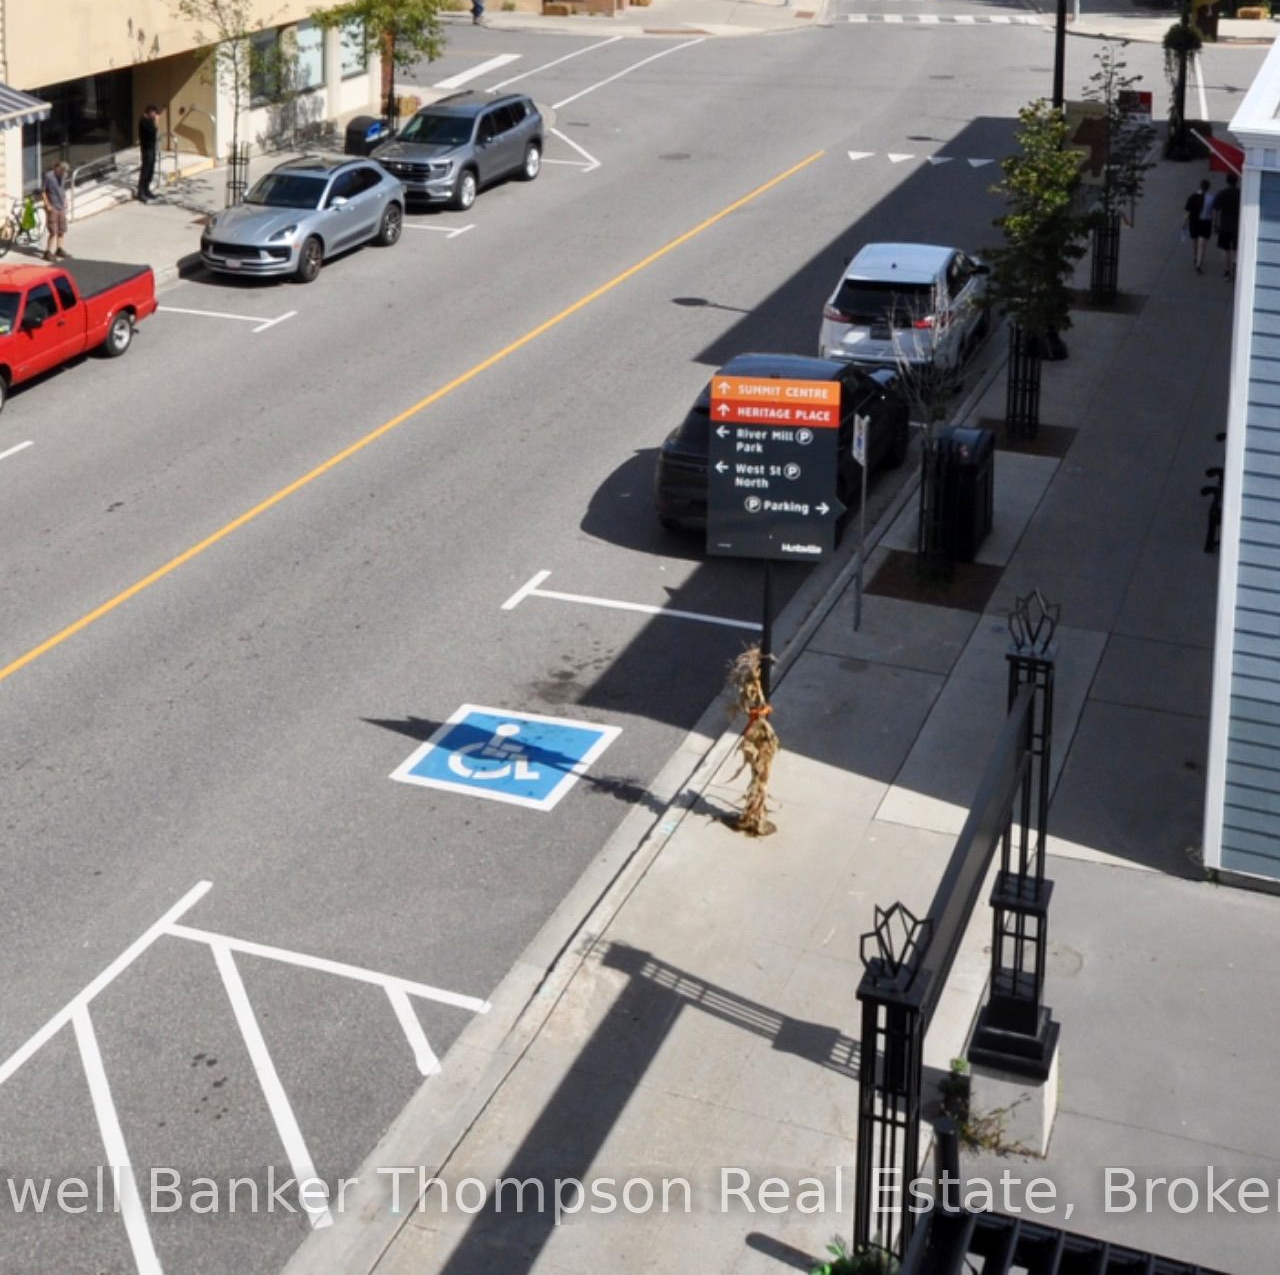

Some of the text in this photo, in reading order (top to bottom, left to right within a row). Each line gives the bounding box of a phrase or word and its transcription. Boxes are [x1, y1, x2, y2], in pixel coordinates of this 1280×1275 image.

[738, 385, 829, 399] SUMMIT CENTRE
[738, 407, 831, 422] HERITAGE PLACE
[736, 428, 767, 440] River
[772, 429, 794, 442] Mill
[736, 442, 763, 453] Park
[736, 463, 765, 475] West
[770, 465, 781, 476] St
[735, 477, 769, 489] North
[764, 499, 810, 515] Parking
